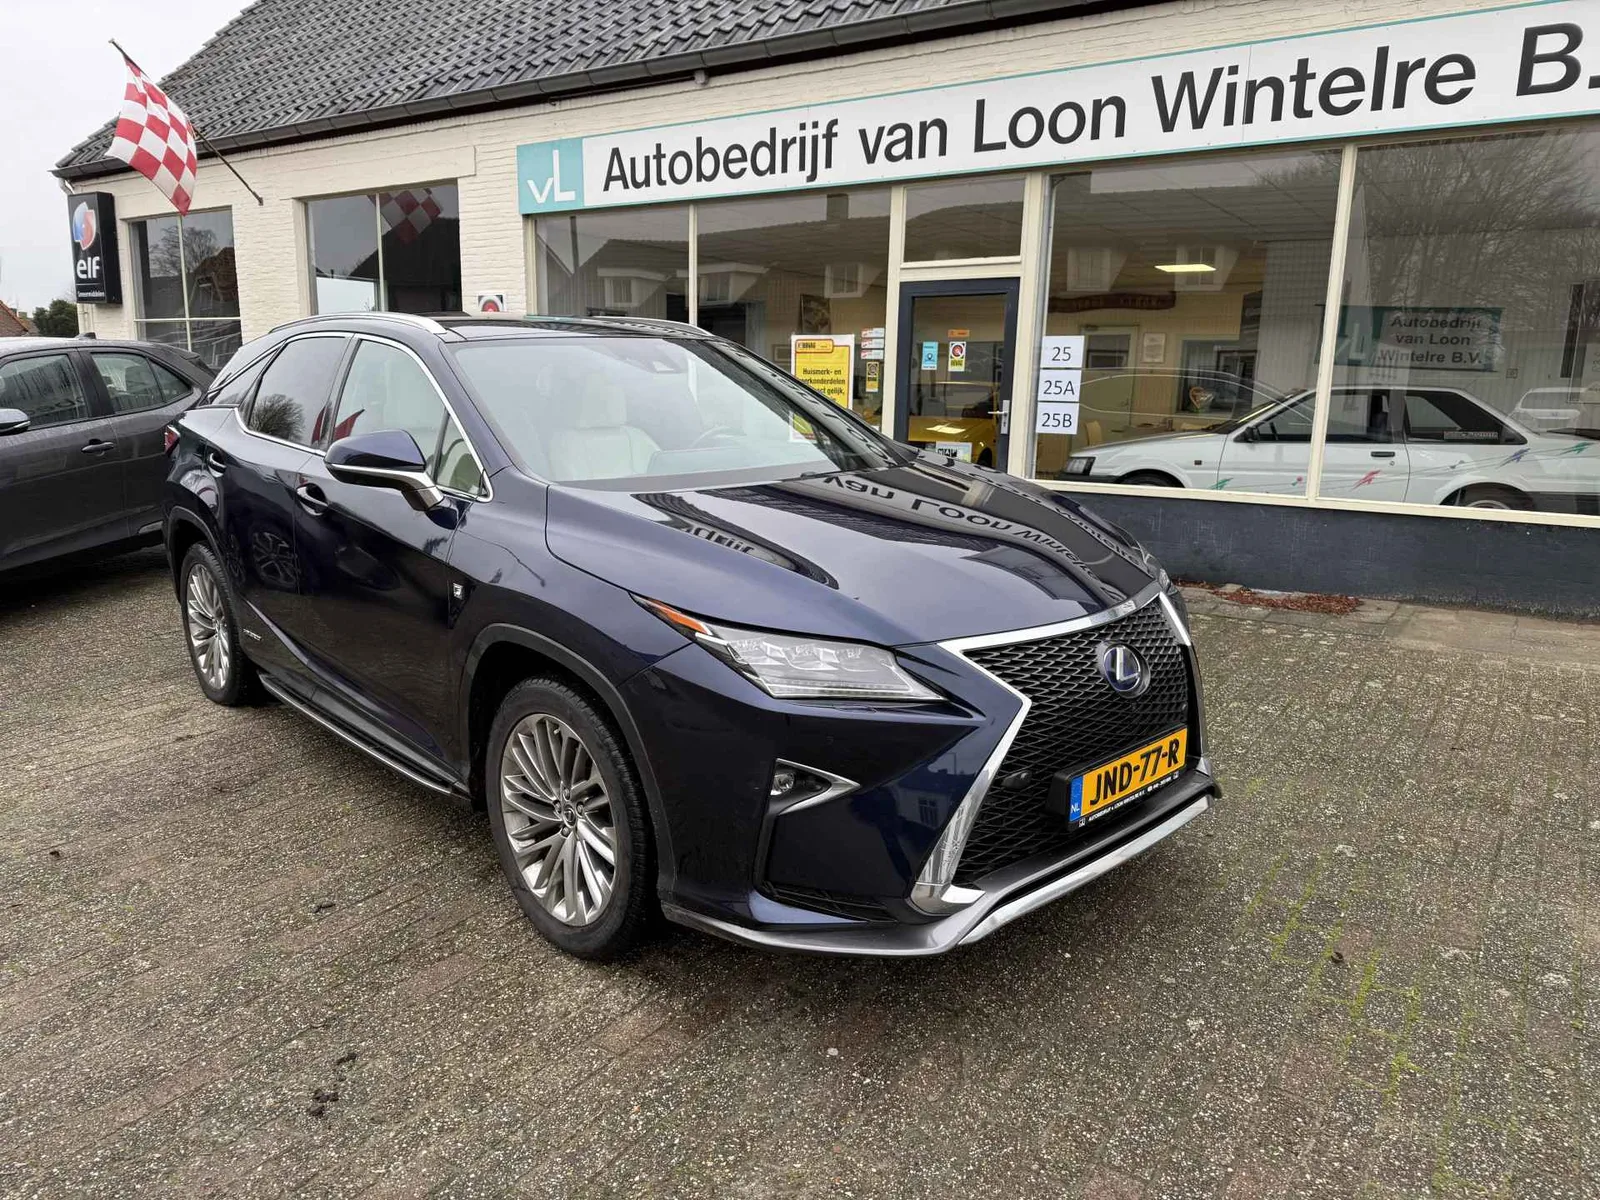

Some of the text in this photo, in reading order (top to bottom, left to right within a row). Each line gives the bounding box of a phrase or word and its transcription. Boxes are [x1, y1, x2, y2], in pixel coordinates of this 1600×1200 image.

[603, 118, 838, 192] Autobedrijf
[858, 117, 948, 165] van
[973, 95, 1126, 153] Loon
[1151, 45, 1476, 133] Wintelre
[76, 256, 100, 279] elf
[1395, 333, 1471, 346] van Loon
[1051, 346, 1072, 362] 25
[1379, 349, 1483, 364] Wintelre B.V.
[1043, 380, 1075, 396] 25A
[1041, 412, 1073, 428] 25B
[1089, 738, 1180, 806] JND-77-R
[1070, 803, 1080, 814] NL
